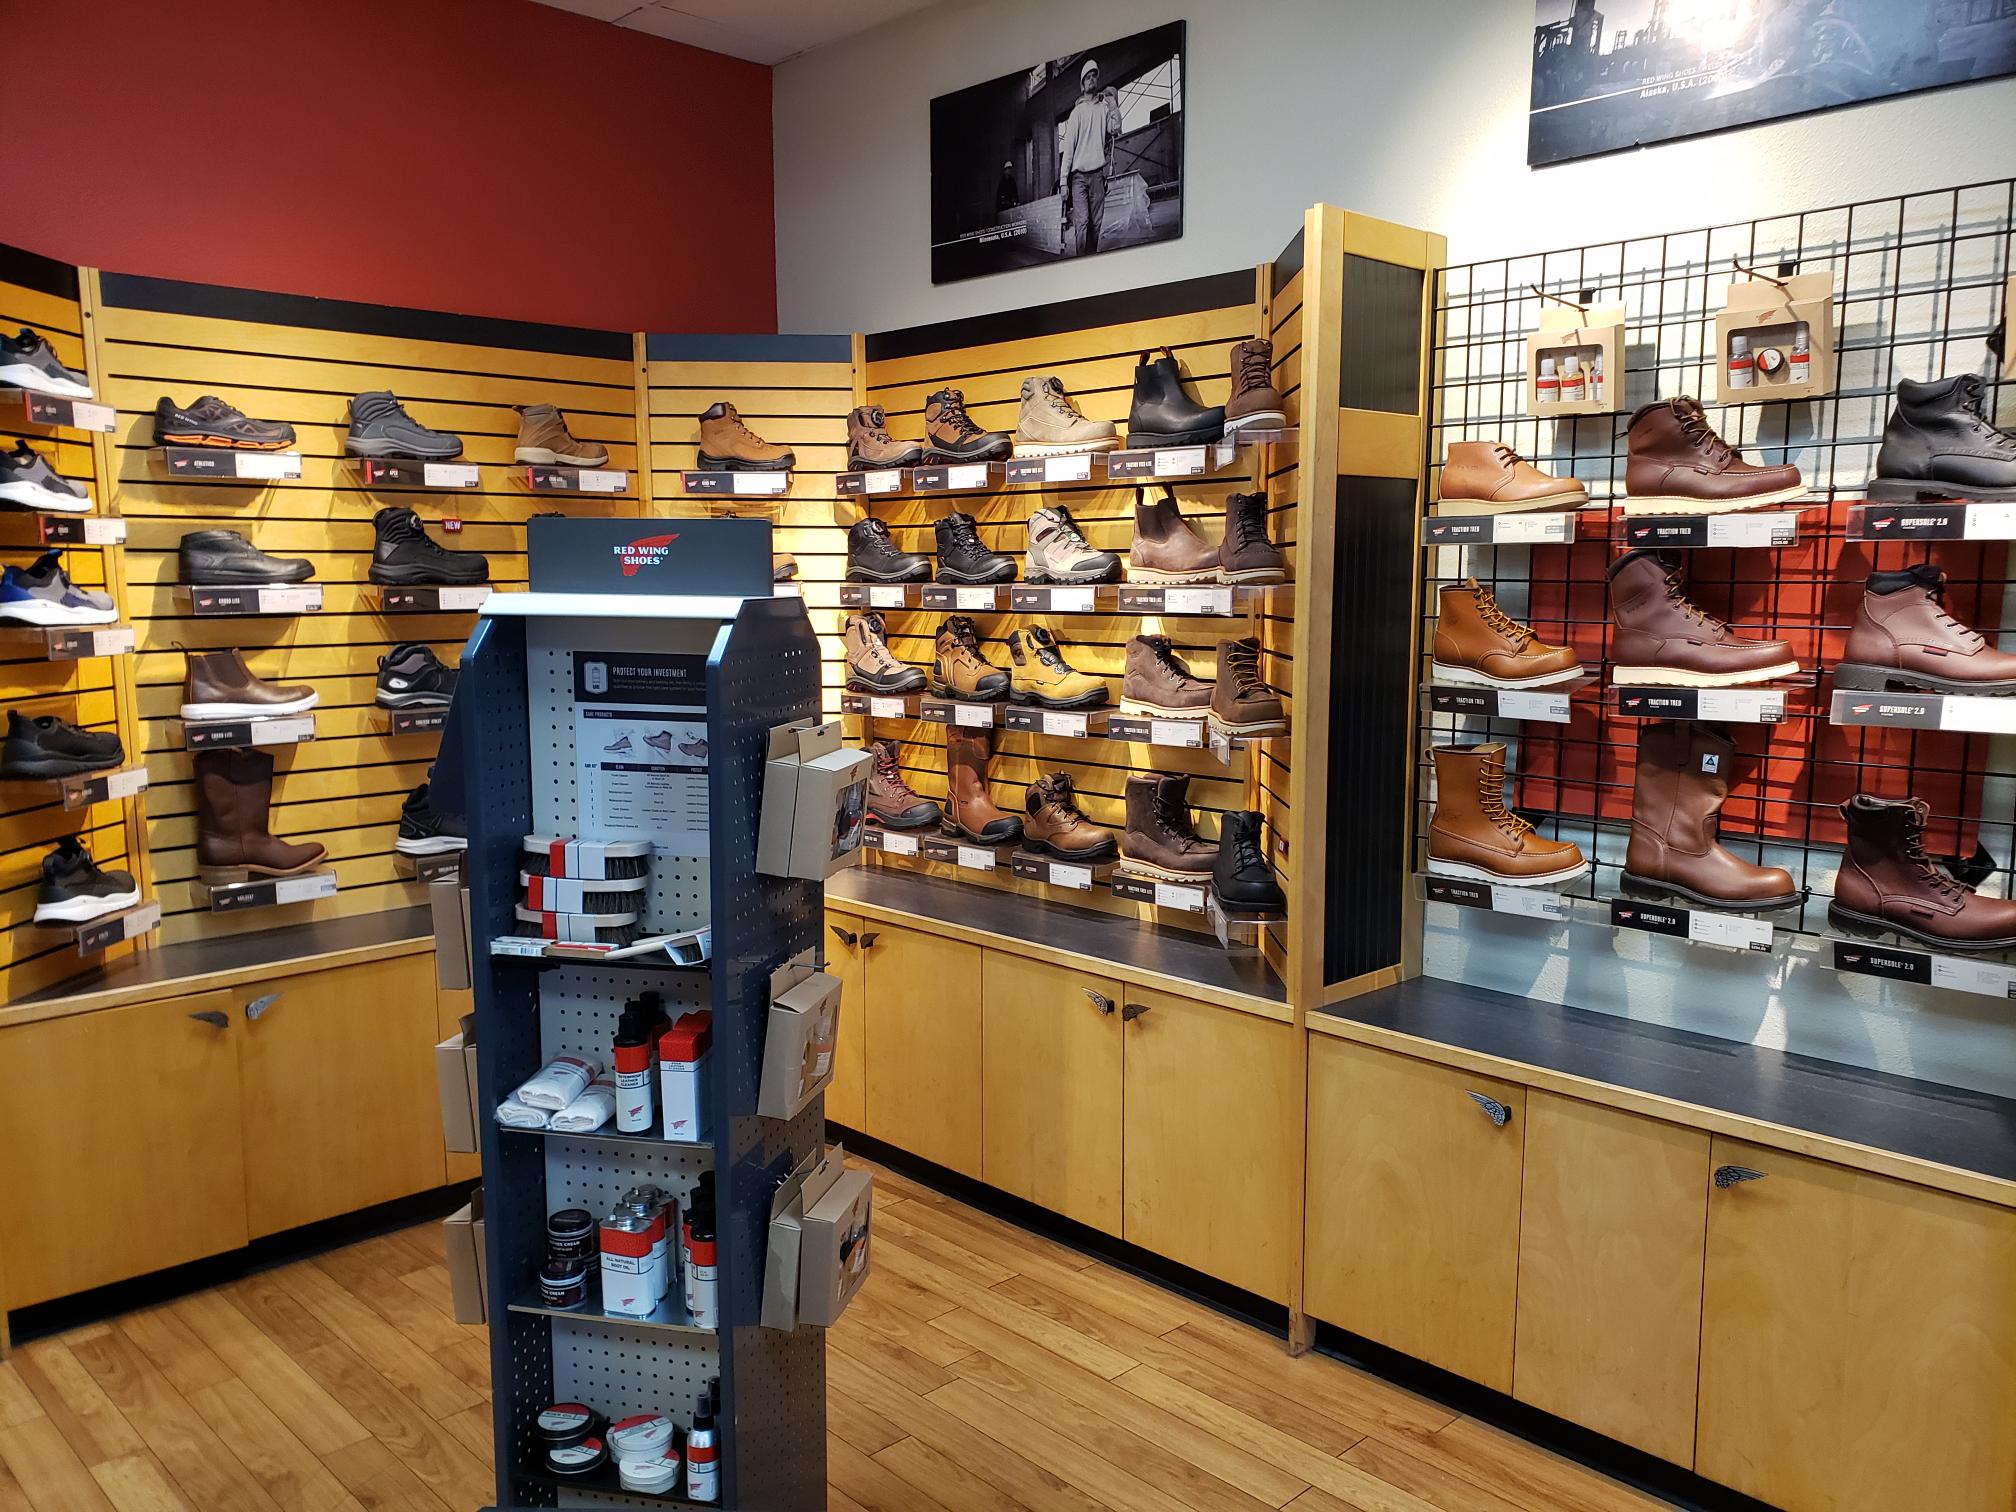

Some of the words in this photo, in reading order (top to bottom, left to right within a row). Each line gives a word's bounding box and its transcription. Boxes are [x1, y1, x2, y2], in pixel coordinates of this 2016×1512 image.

[1675, 67, 1696, 77] SHOES
[1640, 86, 1669, 98] Alaska,
[1672, 79, 1696, 91] U.S.A.
[445, 521, 461, 530] NEW
[1936, 518, 1948, 526] 2.0
[614, 546, 636, 555] RED
[638, 546, 669, 555] WING
[624, 556, 660, 564] SHOES
[612, 667, 636, 676] PROTECT
[638, 668, 652, 676] YOUR
[654, 668, 687, 678] INVESTMENT
[1670, 699, 1682, 707] TRED
[1450, 888, 1468, 897] TRACTION
[1668, 917, 1676, 925] 2.0
[1904, 963, 1914, 971] 2.0
